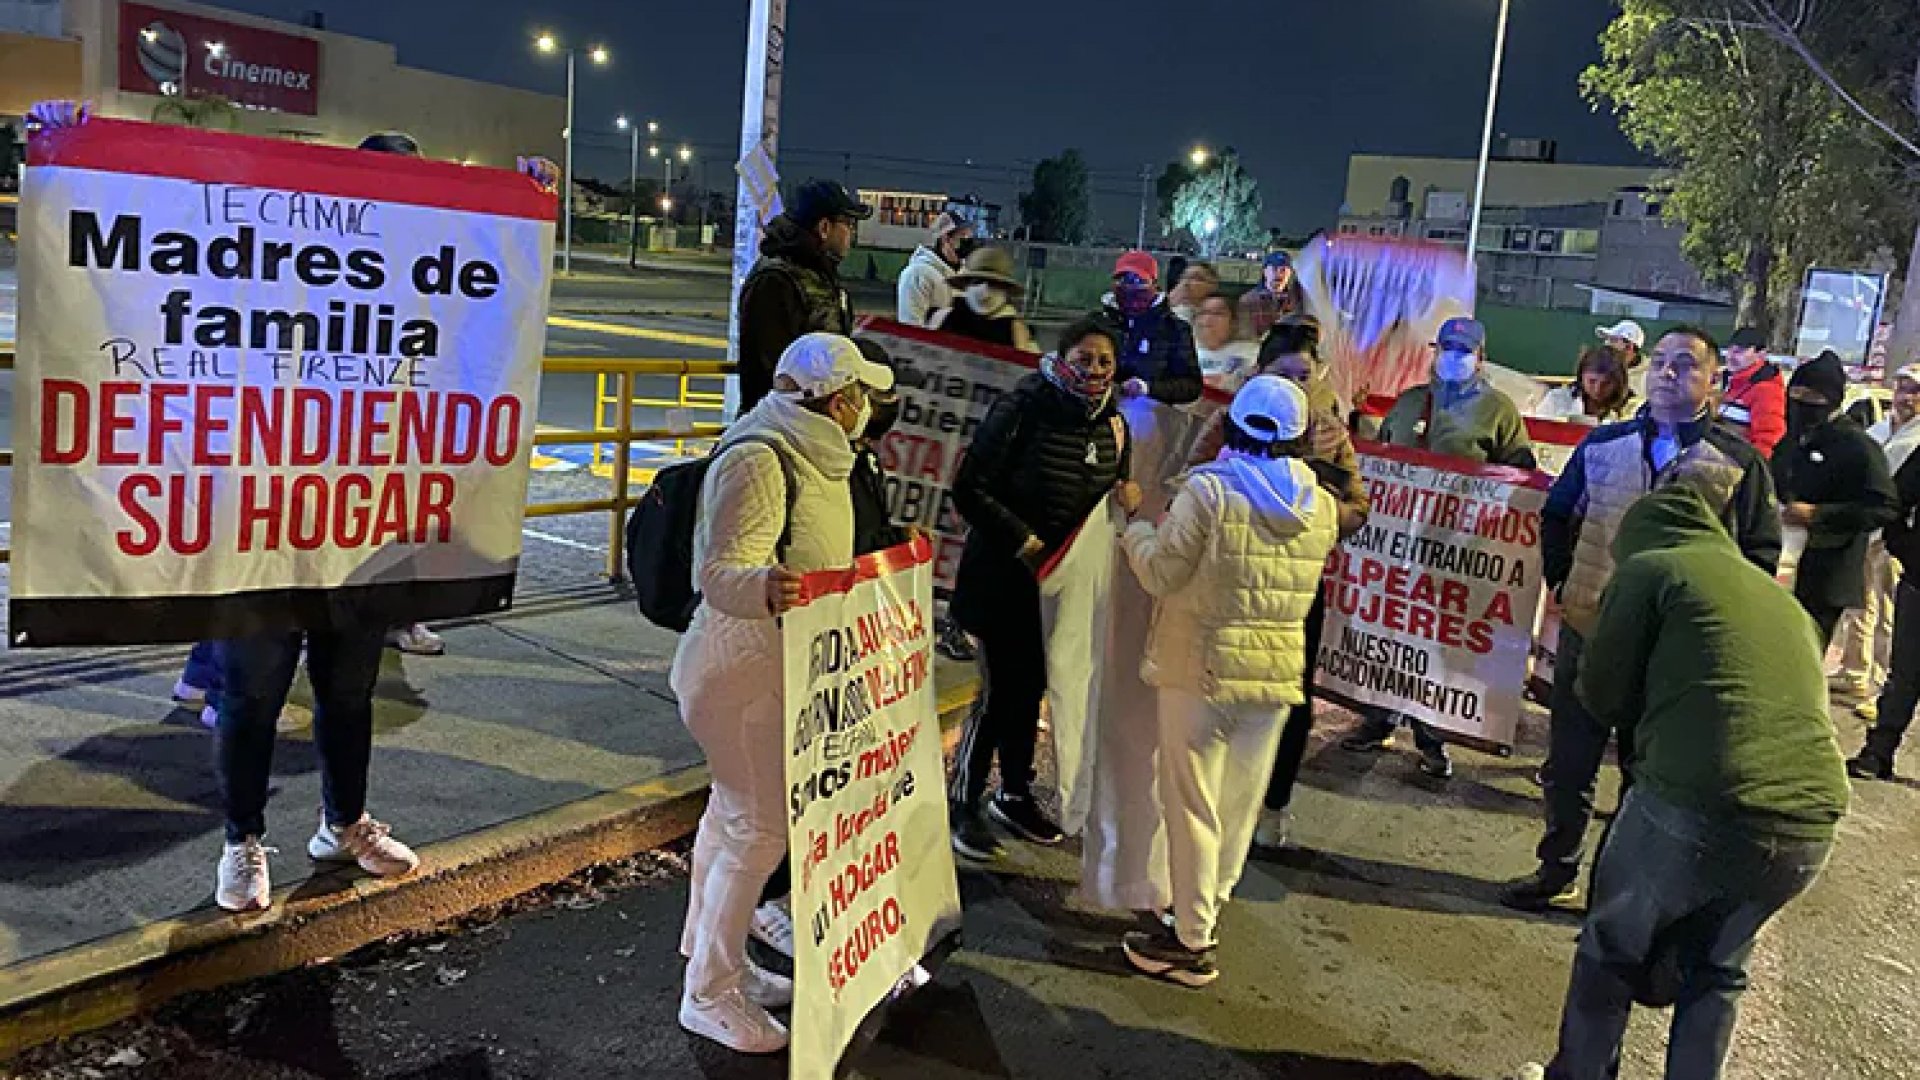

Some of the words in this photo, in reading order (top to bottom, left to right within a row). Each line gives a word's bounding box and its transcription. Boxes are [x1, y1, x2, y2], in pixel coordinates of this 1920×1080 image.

[204, 52, 311, 90] Cinemex
[193, 183, 381, 238] TECAMAC
[69, 209, 386, 290] Madres
[412, 246, 500, 298] de
[161, 290, 438, 357] familia
[99, 338, 236, 380] REAL
[265, 350, 431, 388] FIRENZE
[40, 378, 522, 467] DEFENDIENDO
[116, 472, 213, 556] SU
[237, 472, 455, 554] HOGAR
[1361, 475, 1540, 547] RMITIREMOS
[1323, 546, 1470, 615] OLPEAR
[1481, 590, 1514, 626] A
[1389, 530, 1503, 583] ENTRANDO
[1507, 559, 1525, 587] A
[1316, 645, 1483, 723] ACCIONAMIENTO.
[1340, 625, 1429, 677] NUESTRO
